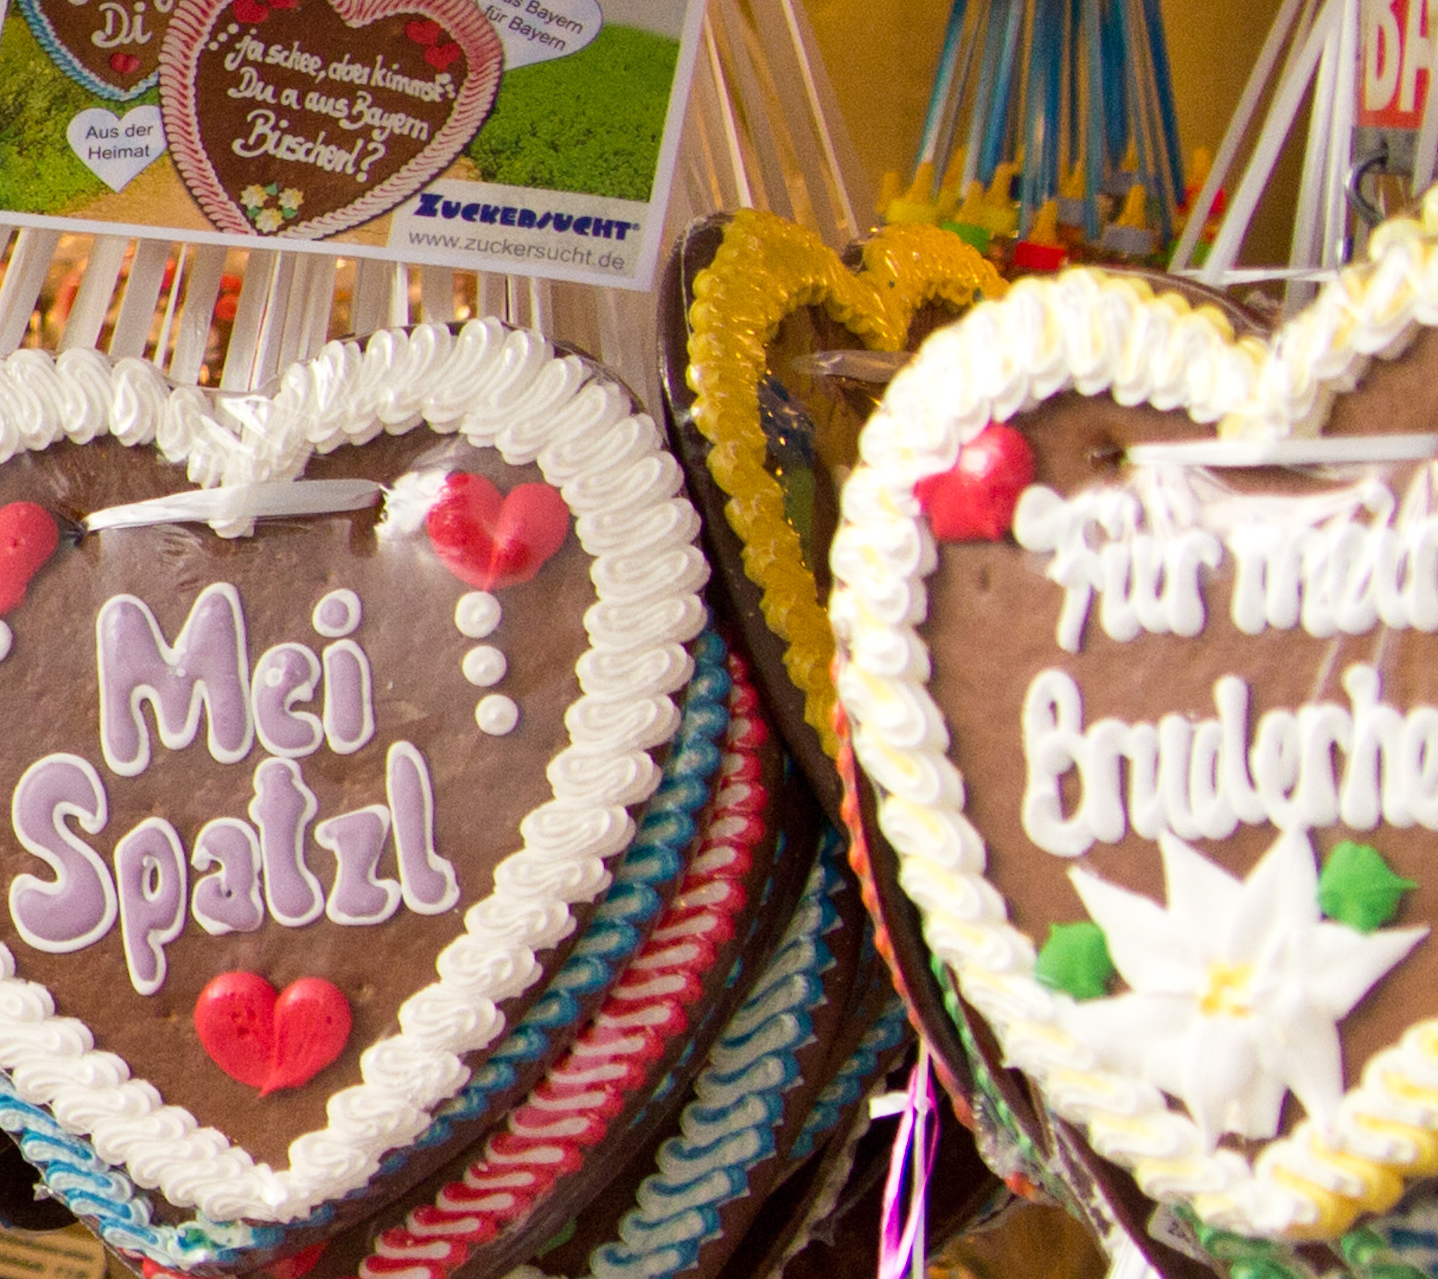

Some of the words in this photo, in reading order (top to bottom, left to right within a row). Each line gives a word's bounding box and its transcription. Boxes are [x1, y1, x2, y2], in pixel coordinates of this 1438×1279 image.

[91, 1, 152, 49] Di
[485, 4, 505, 22] für
[508, 18, 566, 52] Bayern
[525, 1, 584, 36] Bayern
[227, 66, 278, 105] Du
[280, 86, 302, 110] a
[304, 90, 349, 118] aus
[338, 90, 429, 142] Bayern
[86, 125, 120, 140] Aus
[124, 123, 154, 138] der
[88, 145, 151, 160] Heimat
[408, 230, 625, 270] www.zuckersucht.de
[1012, 482, 1226, 654] Für
[97, 581, 374, 777] Mei
[8, 740, 460, 996] Spatzl
